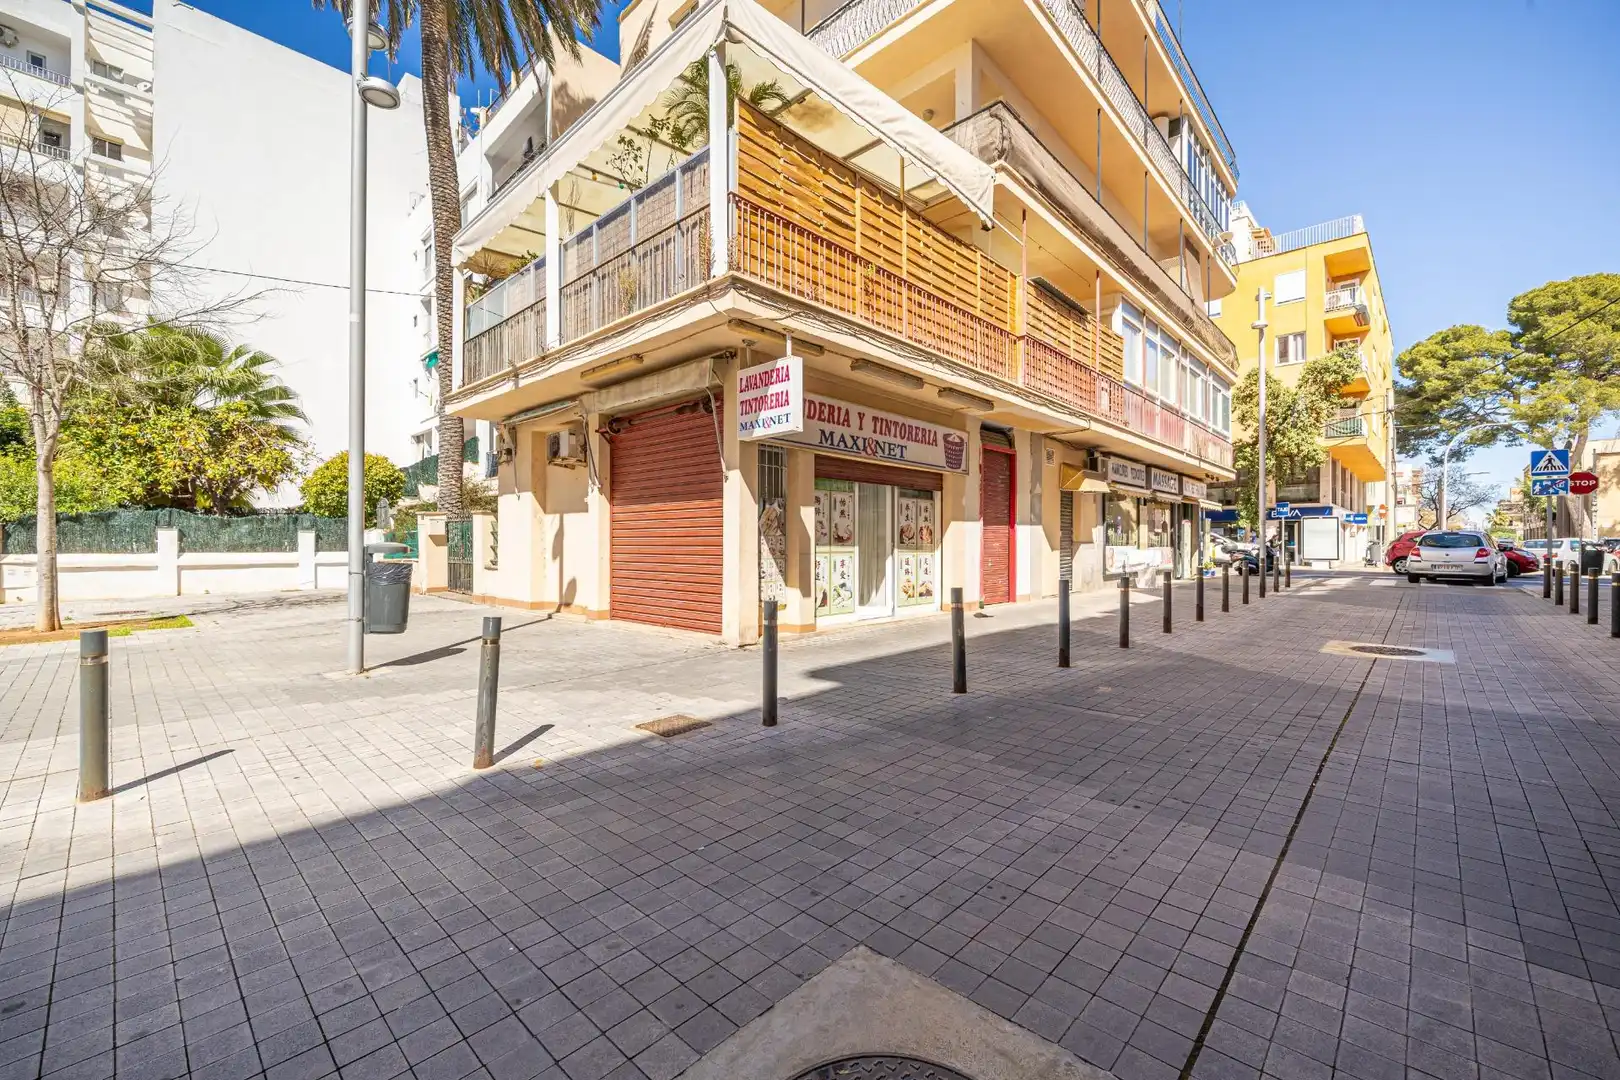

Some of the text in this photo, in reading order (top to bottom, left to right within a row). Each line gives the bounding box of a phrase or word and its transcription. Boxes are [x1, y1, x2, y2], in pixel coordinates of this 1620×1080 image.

[739, 364, 790, 393] LAVANDERIA
[740, 390, 790, 416] TINTORERIA
[739, 413, 791, 432] MAXI&NET
[804, 398, 938, 447] DERIA Y TINTORERIA
[818, 428, 908, 460] MAXI&NET
